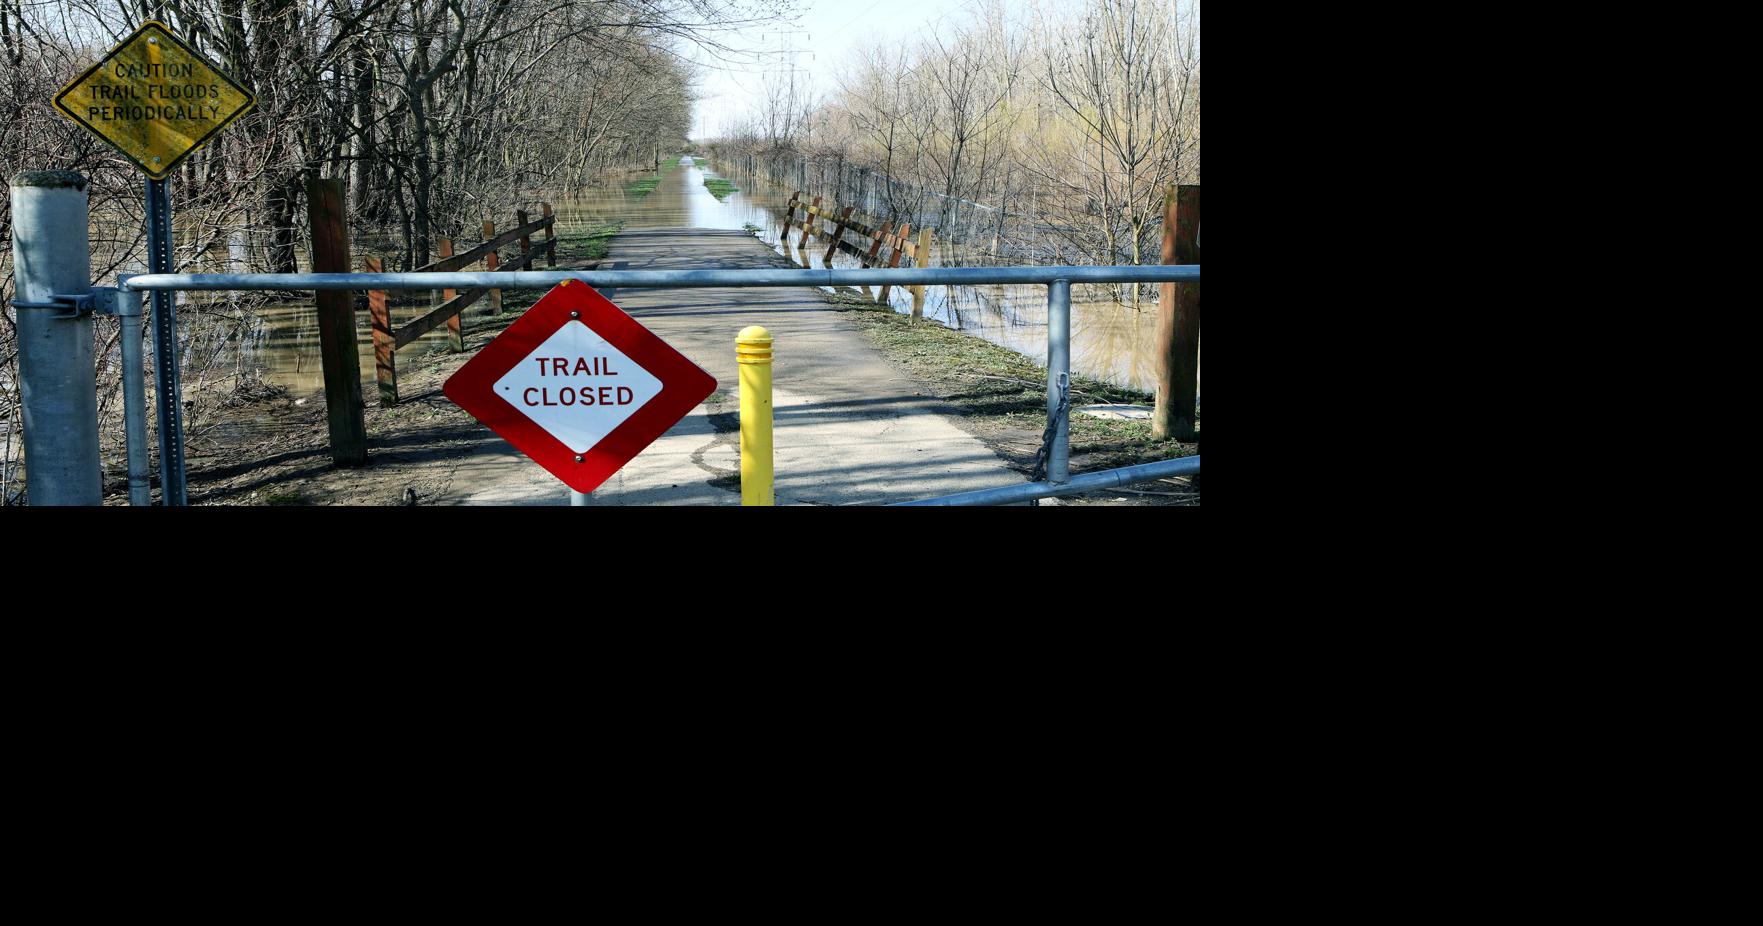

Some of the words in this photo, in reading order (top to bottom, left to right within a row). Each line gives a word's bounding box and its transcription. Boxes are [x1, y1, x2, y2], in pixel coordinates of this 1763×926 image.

[115, 63, 192, 78] CAUTION
[89, 85, 140, 100] TRAIL
[148, 84, 219, 99] FLOODS
[89, 106, 220, 121] PERIODICALLY
[535, 357, 618, 376] TRAIL
[523, 386, 634, 406] CLOSED
